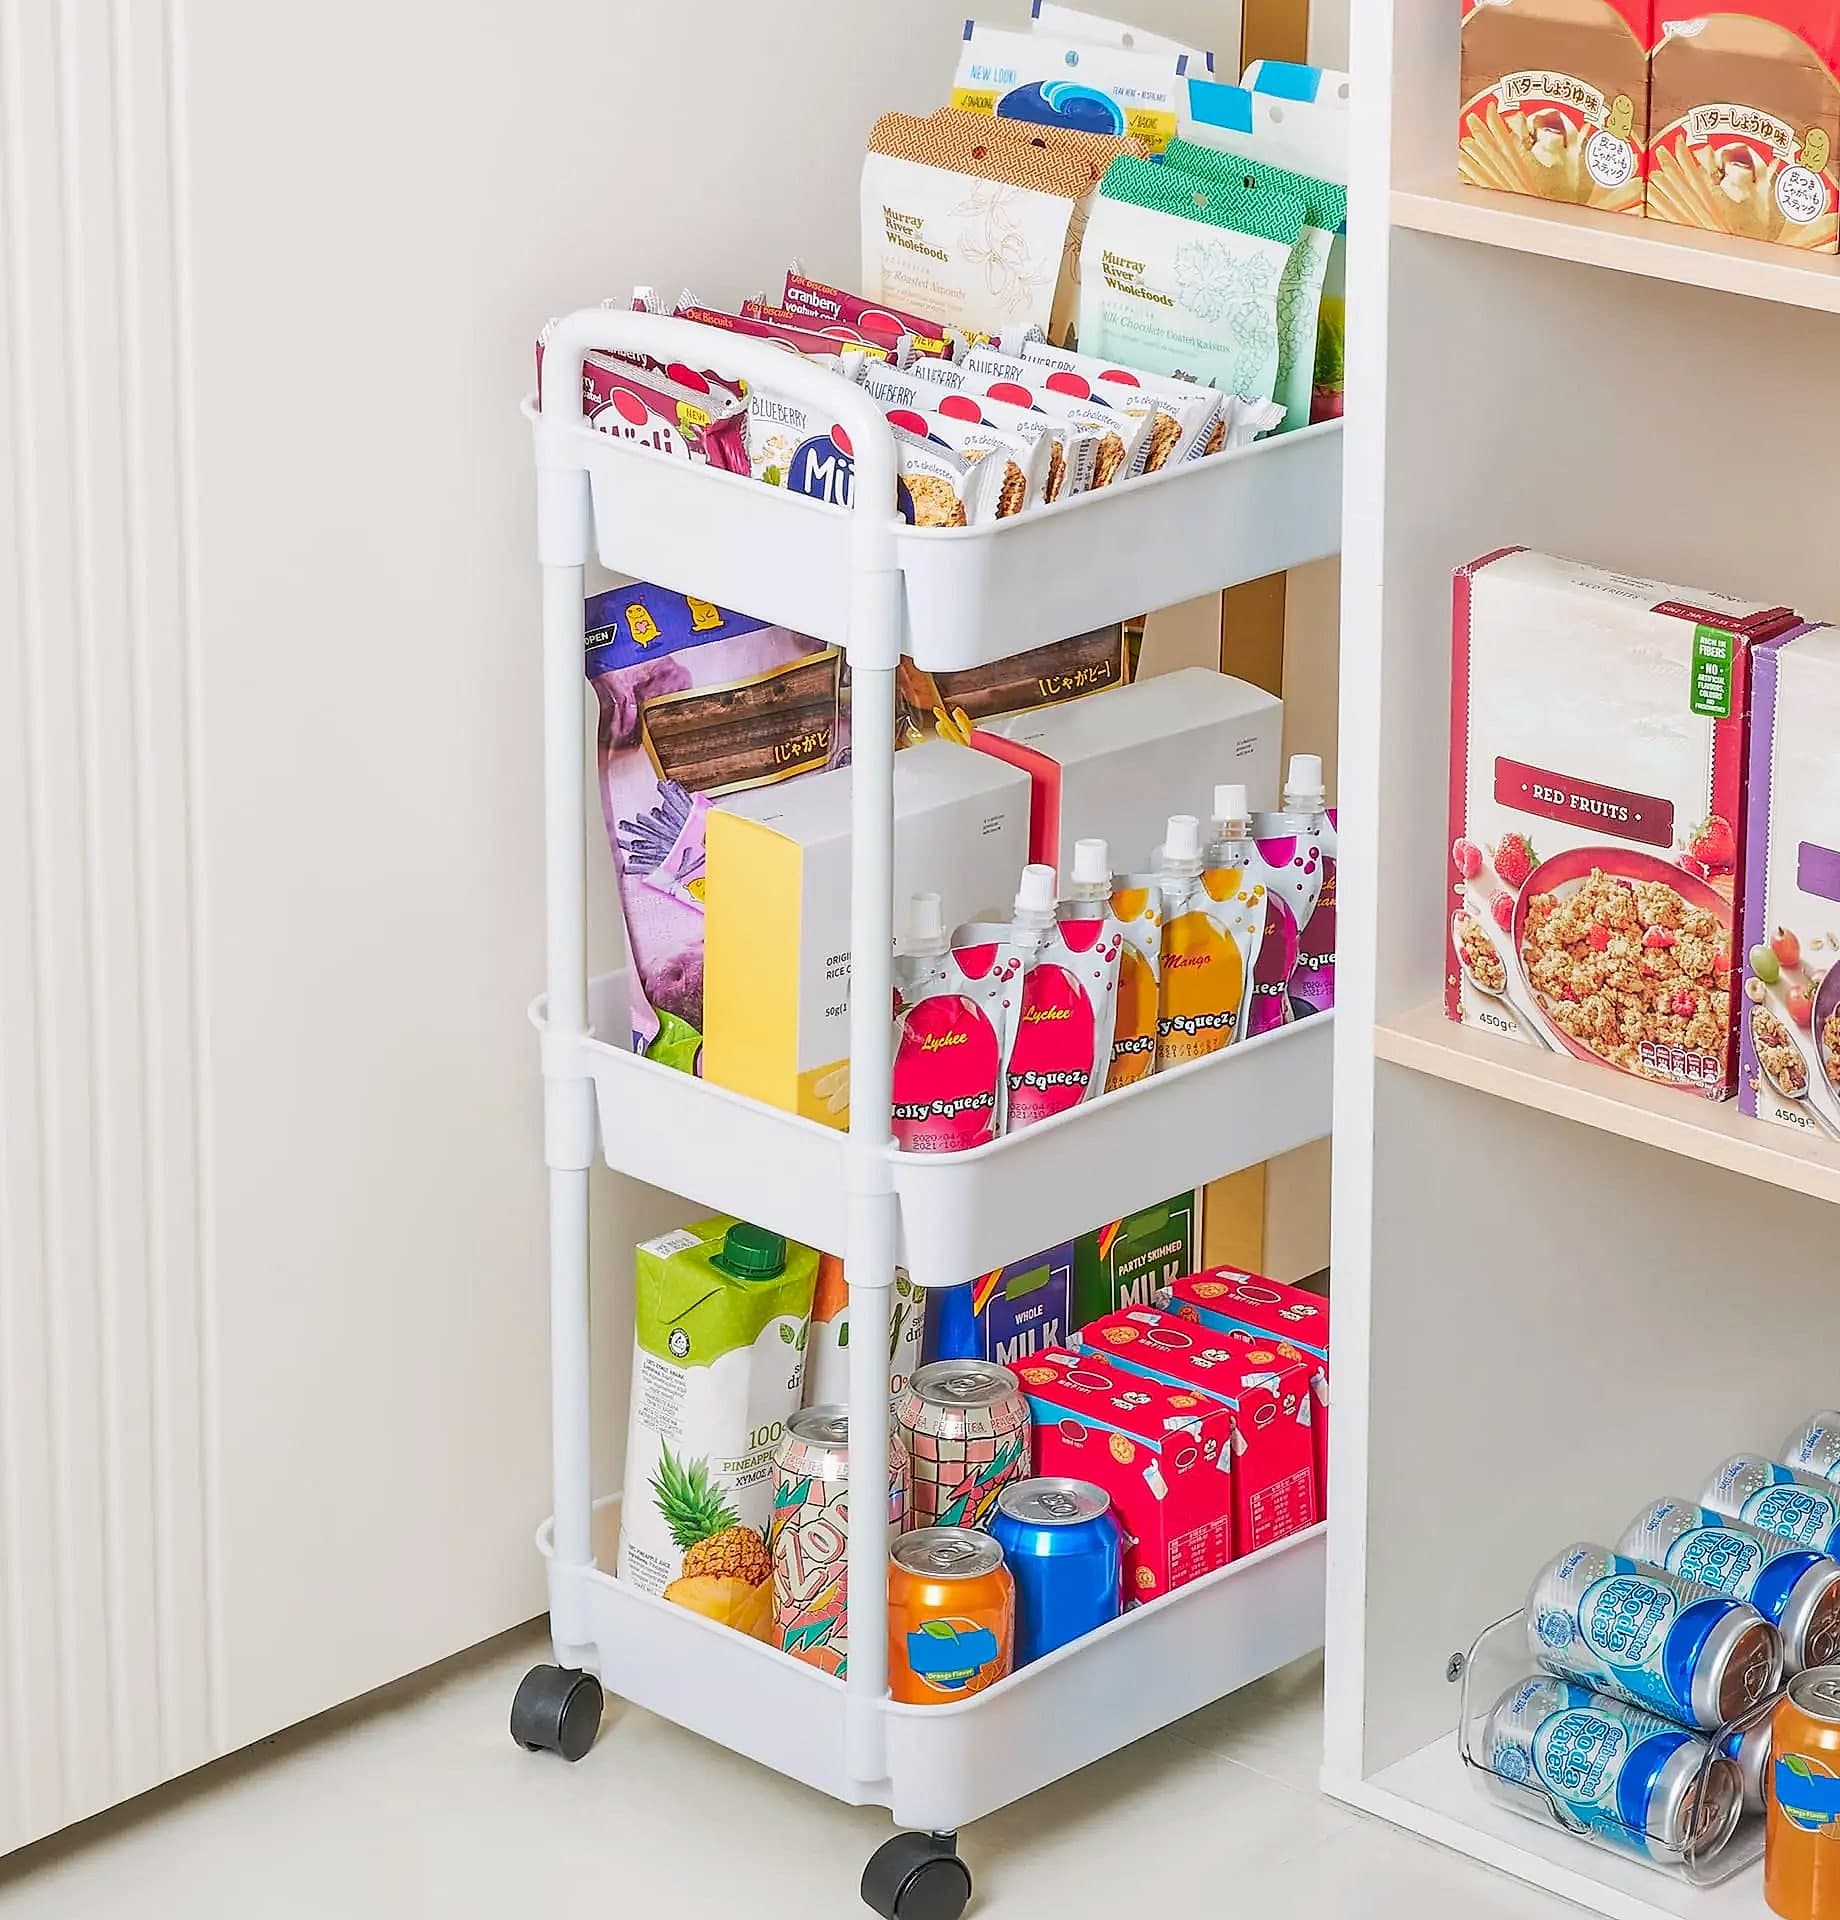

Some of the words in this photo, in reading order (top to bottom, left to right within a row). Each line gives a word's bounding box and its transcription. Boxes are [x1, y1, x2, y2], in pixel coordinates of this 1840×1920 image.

[970, 64, 990, 81] NEW
[1507, 77, 1598, 112] バターしょうゆ味
[1695, 110, 1788, 147] バターしょうゆ味
[882, 204, 924, 230] Murray
[885, 217, 914, 236] River
[885, 231, 950, 263] Wholefoods
[1102, 249, 1146, 274] Murray
[1102, 263, 1135, 282] River
[787, 287, 842, 317] cranberry
[1104, 276, 1175, 308] Wholefoods
[864, 380, 917, 407] BLUEBERRY
[686, 407, 705, 423] NEW
[751, 396, 808, 430] BLUEBERRY
[1699, 644, 1727, 659] FIBERS
[1705, 663, 1719, 675] NO
[1533, 784, 1566, 806] RED
[1569, 793, 1629, 822] FRUITS
[826, 966, 845, 980] RICE
[1161, 952, 1212, 969] Mango
[1023, 1005, 1073, 1025] Lychee
[1174, 1011, 1236, 1035] Squeeze
[921, 1030, 969, 1052] Lychee
[1024, 1070, 1089, 1091] Squeeze
[931, 1093, 995, 1118] Squeeze
[1118, 1254, 1147, 1276] PARTLY
[1147, 1240, 1183, 1264] SKIMMED
[1120, 1259, 1180, 1310] MILK
[1015, 1304, 1044, 1325] WHOLE
[996, 1317, 1060, 1367] MILK
[723, 1450, 775, 1472] PINEAPPL
[1591, 1579, 1640, 1648] Water
[1609, 1585, 1657, 1651] Soda
[927, 1671, 951, 1681] Orange
[952, 1667, 974, 1678] Flavor
[1546, 1713, 1592, 1784] Water
[1564, 1718, 1609, 1788] Soda
